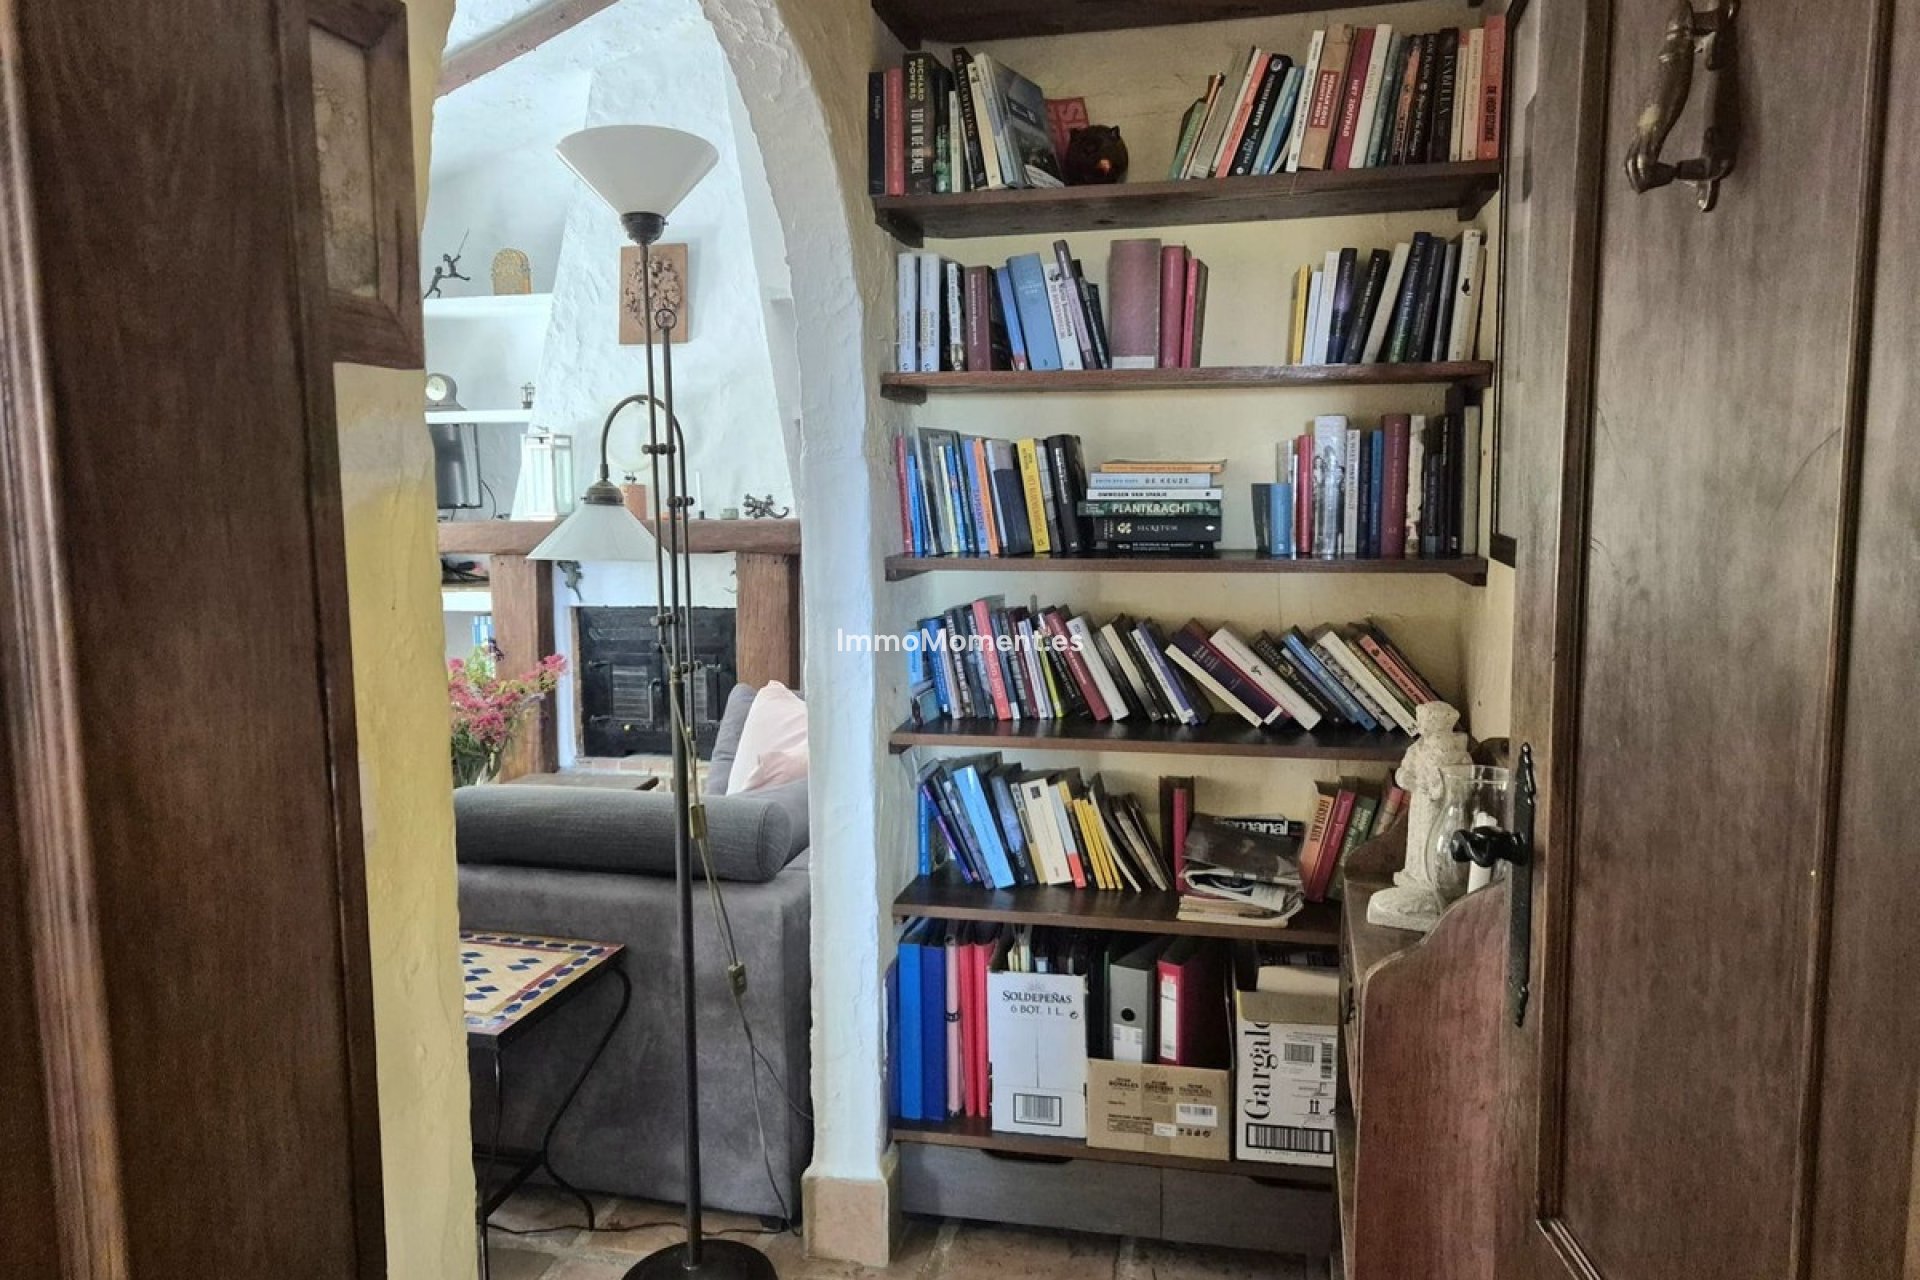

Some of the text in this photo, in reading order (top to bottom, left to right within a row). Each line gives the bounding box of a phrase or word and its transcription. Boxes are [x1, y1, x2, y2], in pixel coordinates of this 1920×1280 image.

[908, 60, 916, 100] POWERS
[916, 58, 924, 101] RICHARD
[1351, 79, 1361, 96] HET
[911, 108, 924, 122] TOT
[1112, 502, 1191, 513] PLANTKRACHT
[1002, 989, 1073, 1004] SOLDEPEÑAS
